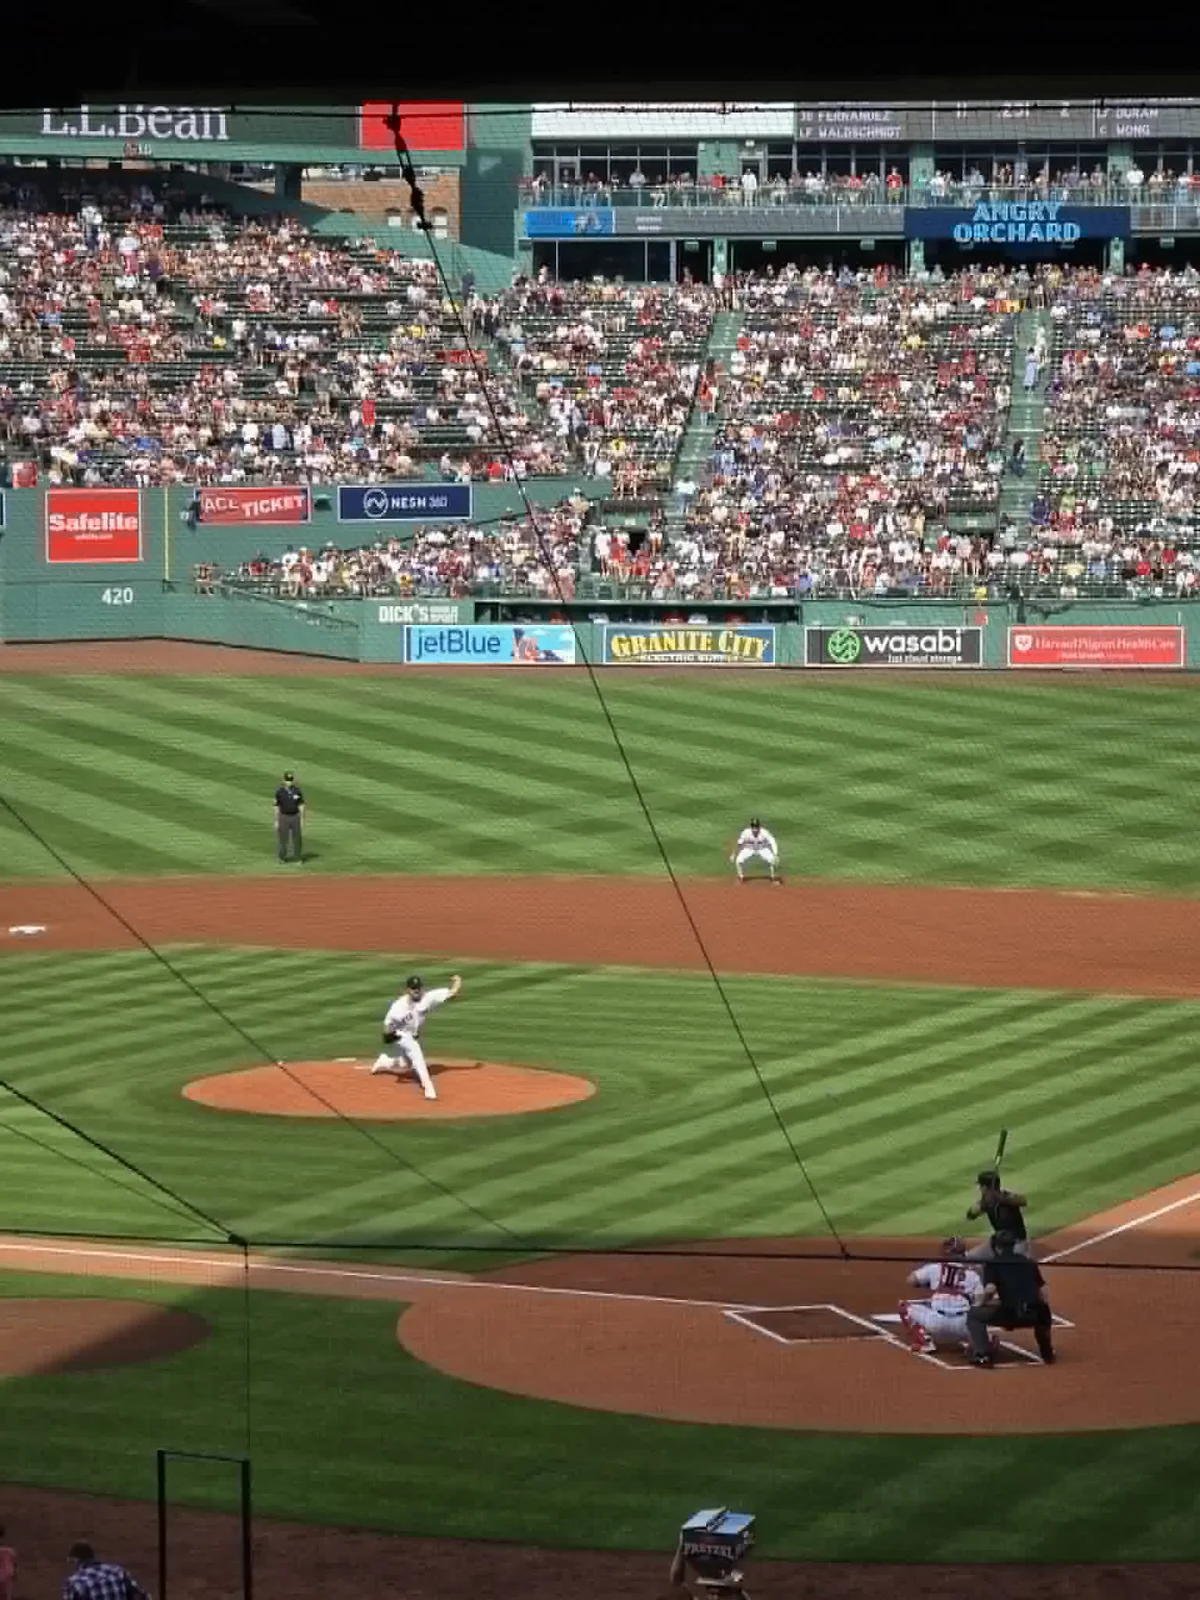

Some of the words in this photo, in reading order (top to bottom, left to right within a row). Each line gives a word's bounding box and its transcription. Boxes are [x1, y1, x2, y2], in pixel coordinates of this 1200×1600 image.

[41, 104, 230, 140] L.L.Bean
[1115, 107, 1159, 120] DURAN
[1115, 123, 1151, 136] WONG
[973, 200, 1063, 221] ANGRY
[953, 222, 1081, 242] ORCHARD
[241, 495, 304, 518] TICKET
[49, 511, 138, 531] Safelite
[101, 587, 133, 605] 420
[378, 603, 429, 624] DICK'S
[416, 628, 501, 660] jetBlue
[611, 630, 713, 657] GRANITE
[718, 630, 768, 661] CITY
[863, 628, 962, 653] wasabi
